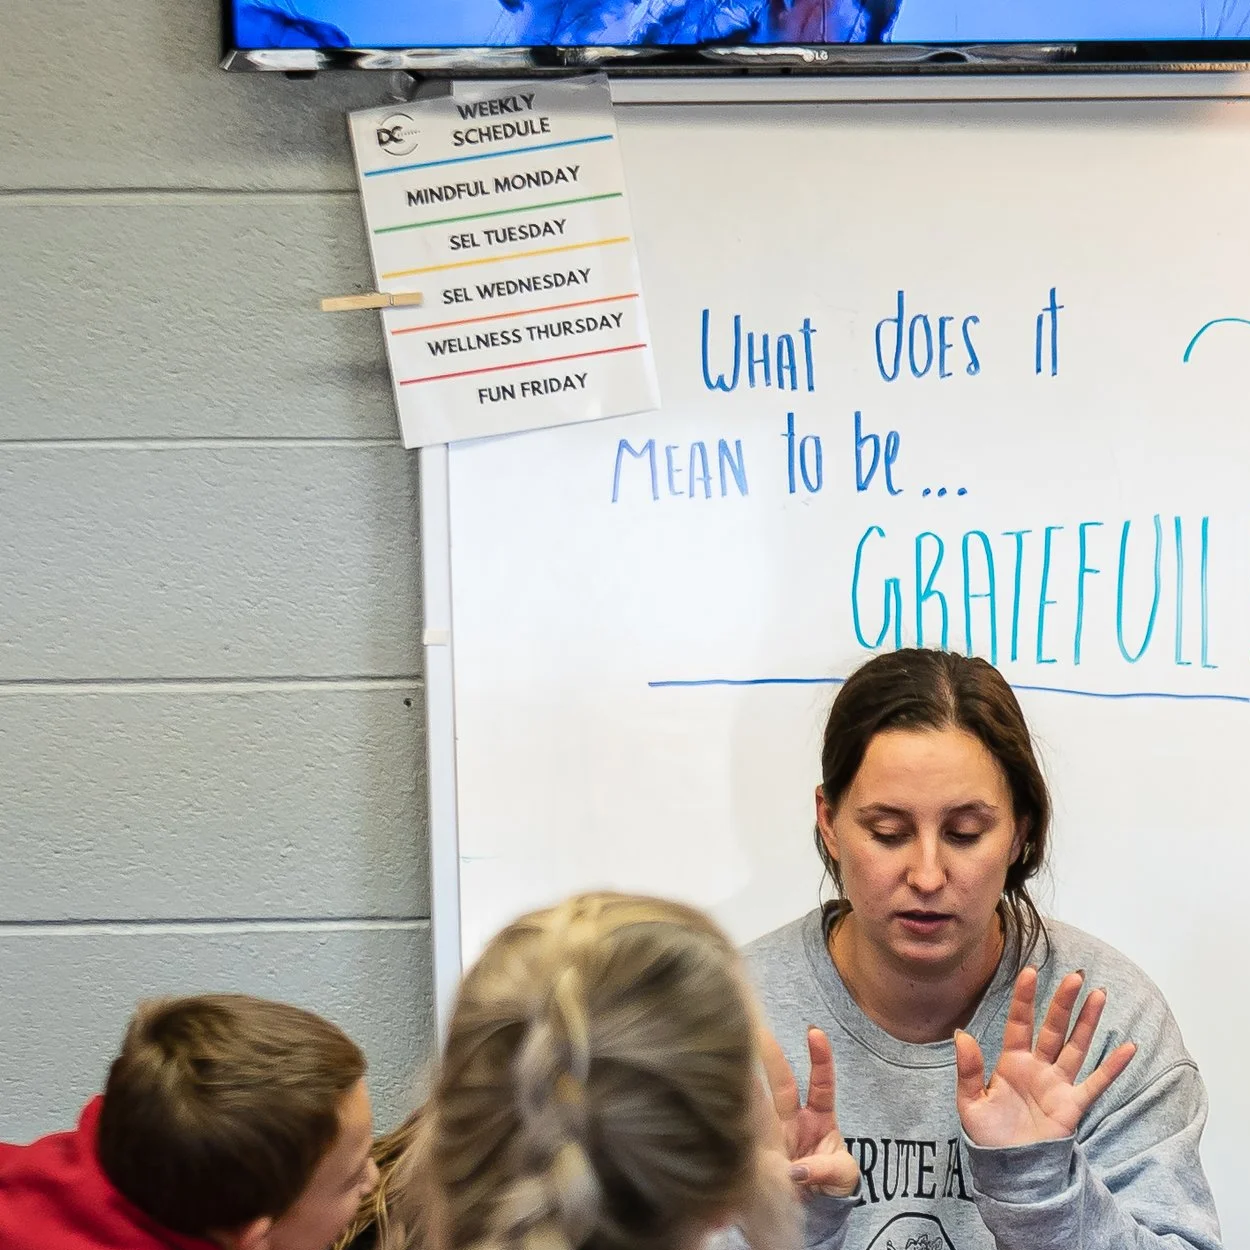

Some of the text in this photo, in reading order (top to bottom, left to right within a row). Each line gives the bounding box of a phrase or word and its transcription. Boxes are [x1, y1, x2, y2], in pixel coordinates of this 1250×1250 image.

[457, 93, 536, 120] WEEKLY
[452, 117, 551, 147] SCHEDULE
[406, 165, 580, 206] MINDFUL MONDAY
[449, 219, 567, 251] SEL TUESDAY
[442, 268, 592, 305] SEL WEDNESDAY
[427, 312, 624, 357] WELLNESS THURSDAY
[478, 373, 588, 405] FUN FRIDAY
[611, 438, 749, 504] MEAN
[781, 412, 823, 494] to
